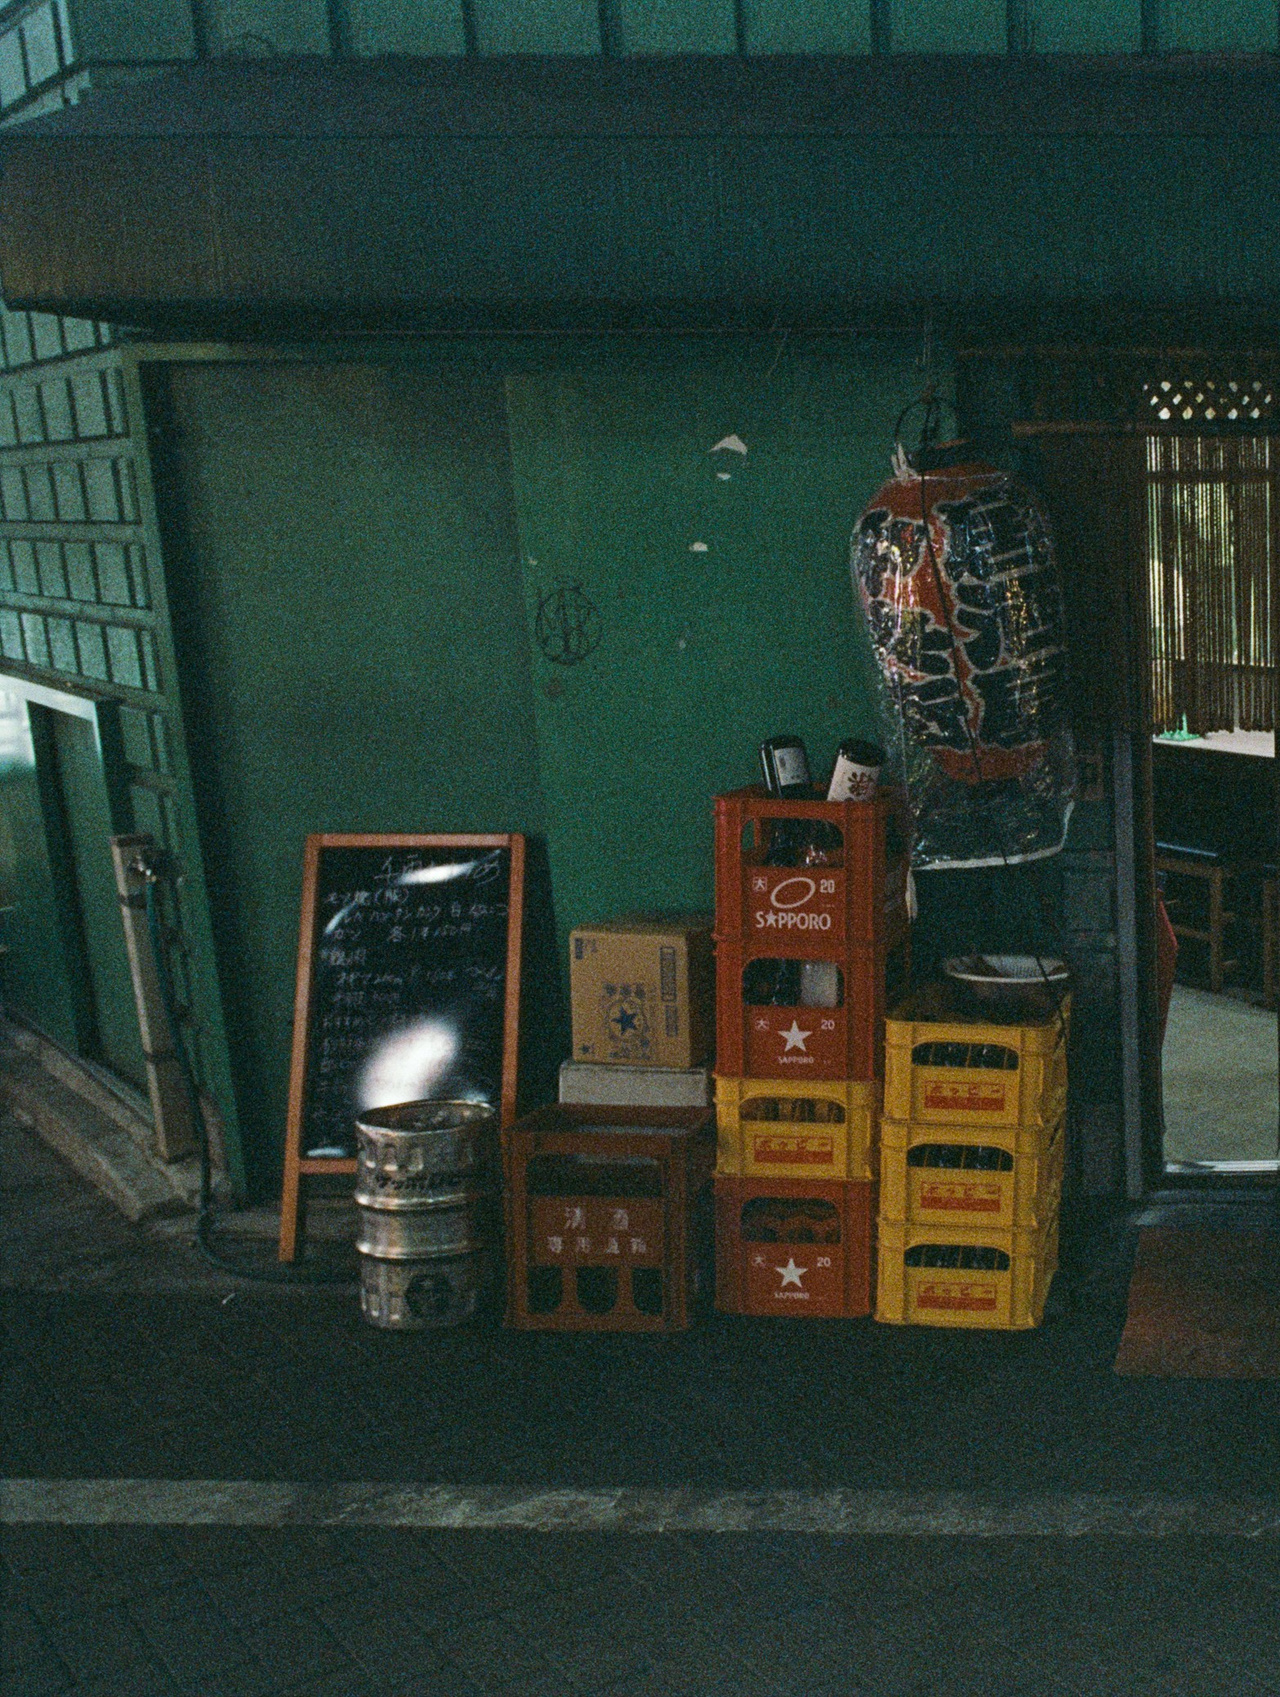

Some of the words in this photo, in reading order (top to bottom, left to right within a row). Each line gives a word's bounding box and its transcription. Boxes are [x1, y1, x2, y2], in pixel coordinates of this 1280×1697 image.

[819, 878, 836, 893] 20
[820, 1018, 836, 1031] 20
[777, 1056, 815, 1065] SAPPORO
[816, 1256, 832, 1269] 20
